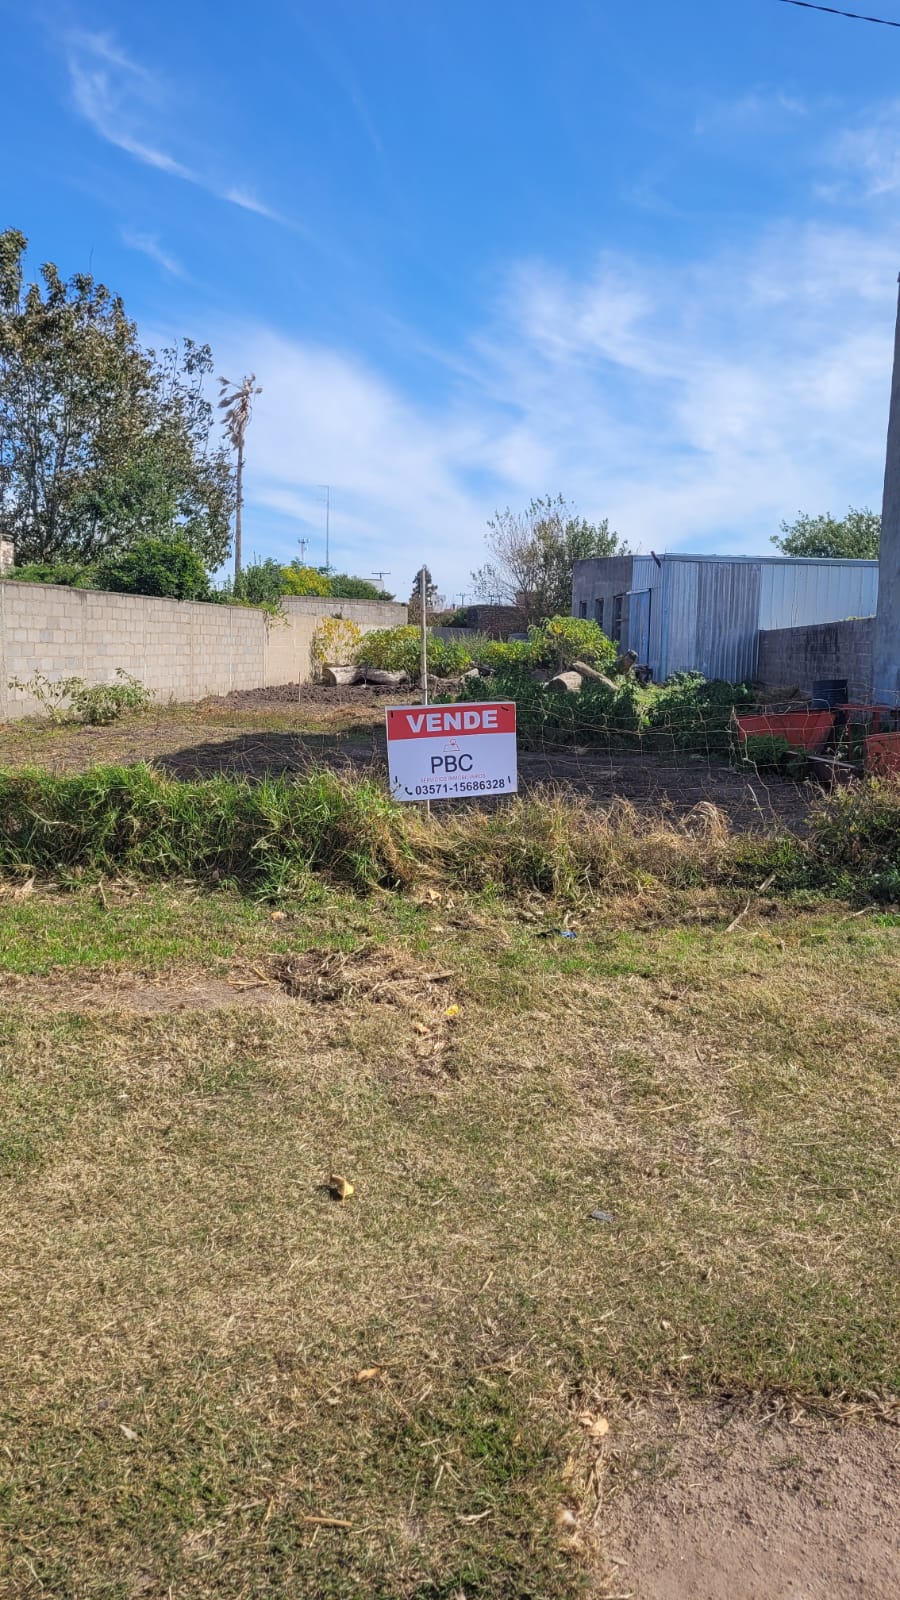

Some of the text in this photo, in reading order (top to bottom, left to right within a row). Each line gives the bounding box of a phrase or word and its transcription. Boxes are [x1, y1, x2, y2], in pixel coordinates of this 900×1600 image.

[406, 709, 498, 733] VENDE
[430, 753, 473, 774] PBC
[415, 779, 505, 795] 03571-15686328
